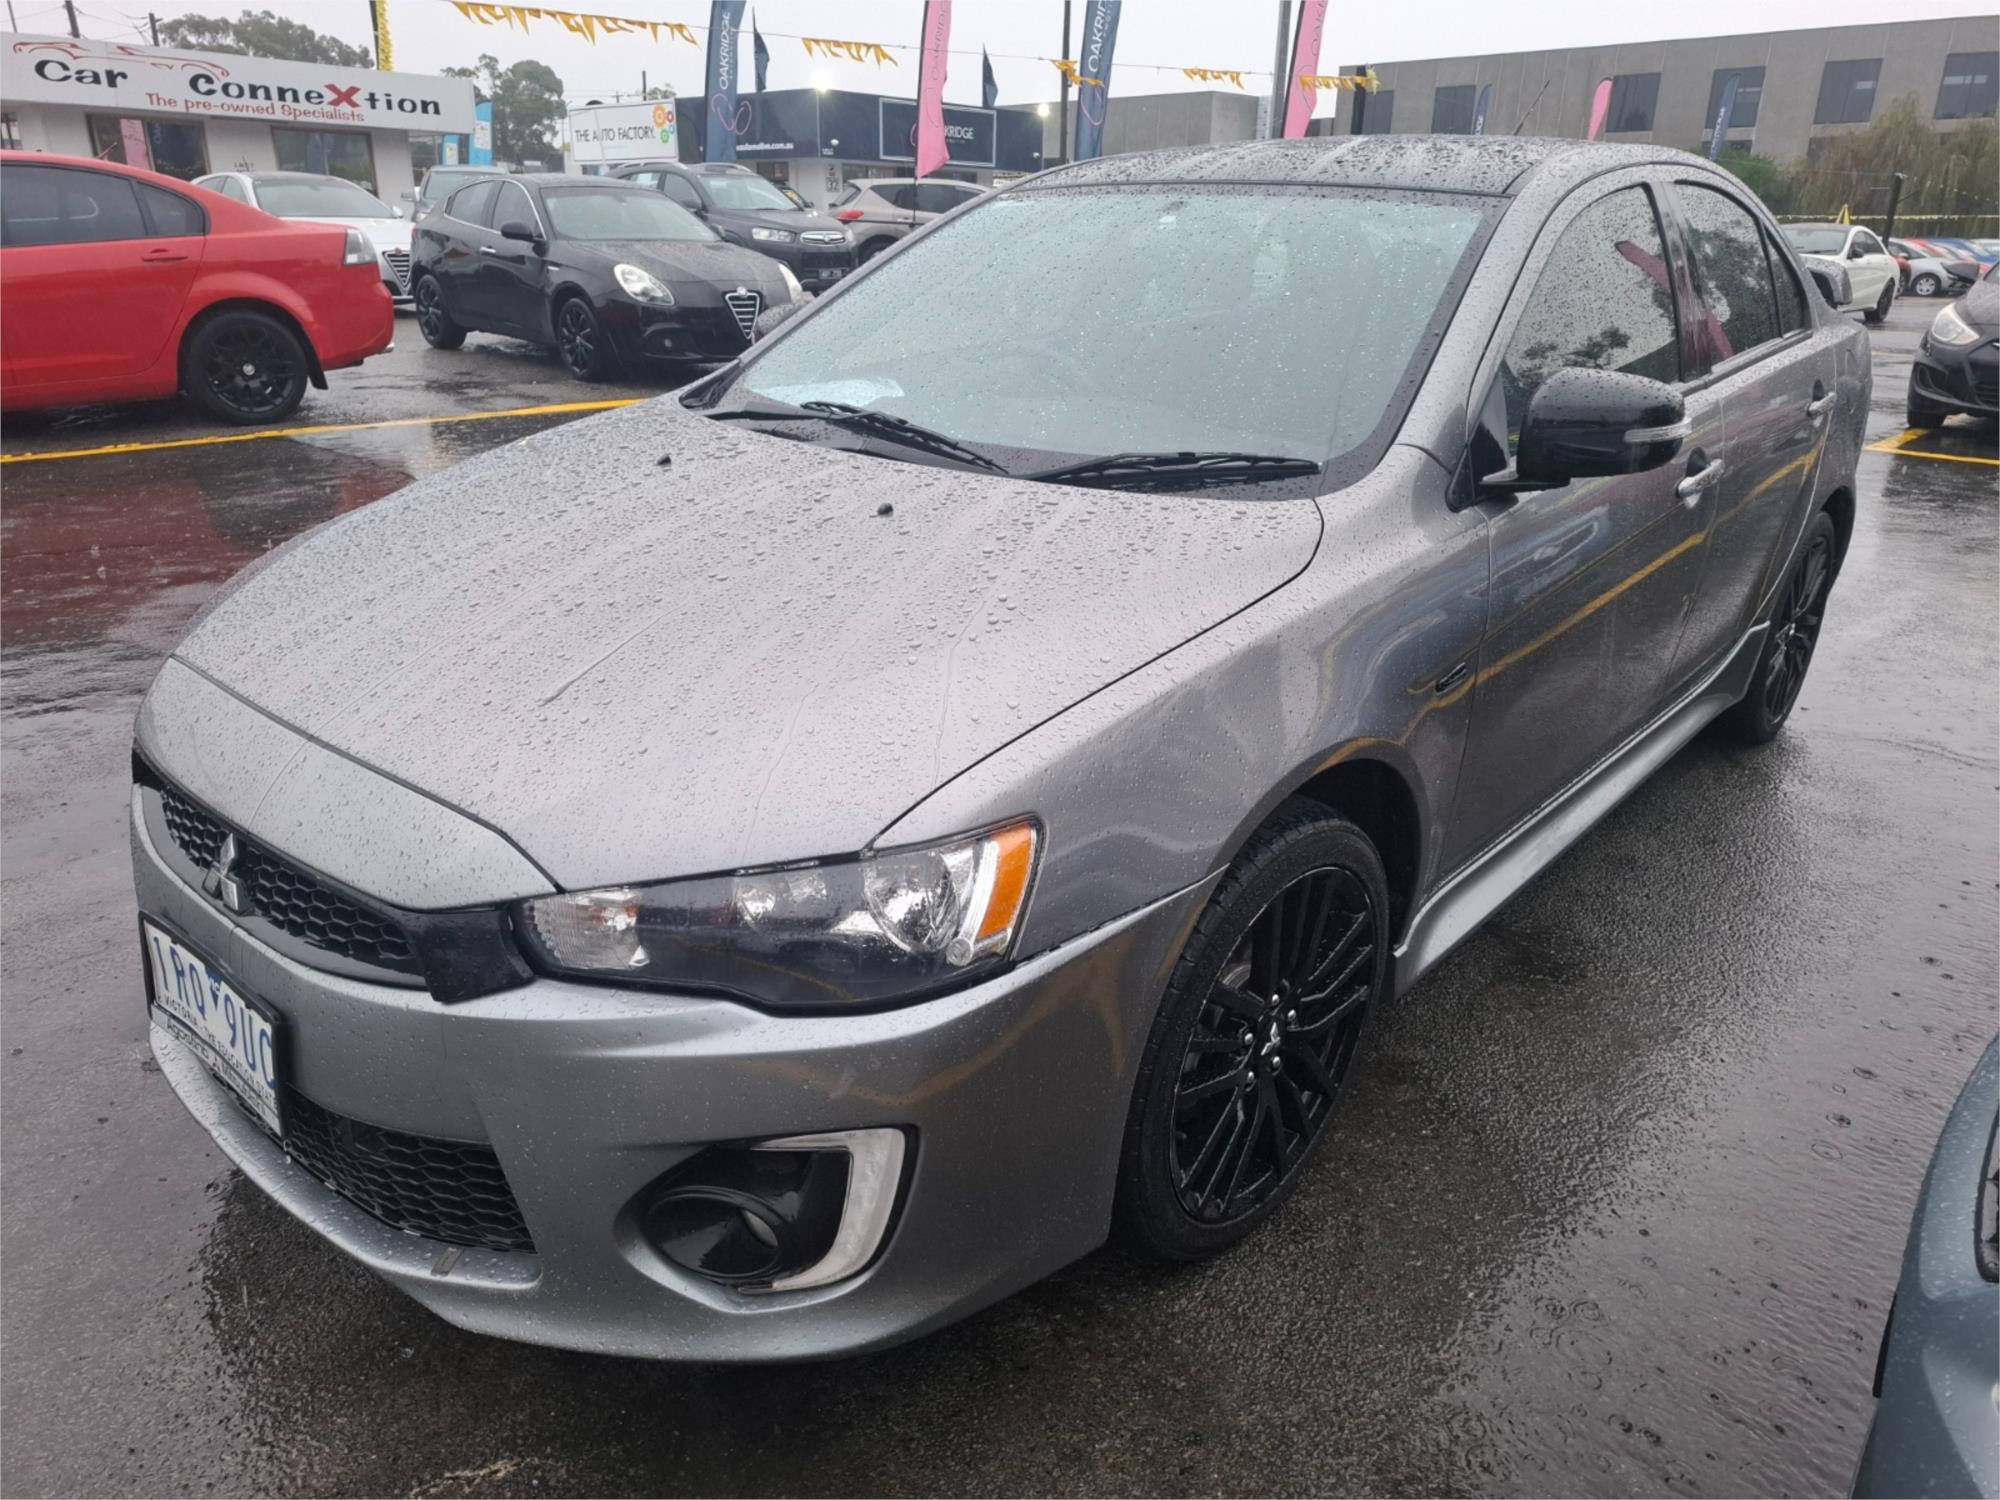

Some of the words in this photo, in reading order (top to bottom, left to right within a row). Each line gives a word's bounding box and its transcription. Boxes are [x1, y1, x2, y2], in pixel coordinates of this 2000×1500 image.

[720, 11, 730, 90] OAKRIDGE
[34, 59, 128, 88] Car
[189, 72, 441, 116] ConneXtion
[146, 93, 177, 107] The
[183, 98, 275, 115] pre-owned
[281, 104, 365, 121] Specialists
[575, 128, 590, 142] THE
[165, 995, 198, 1027] VICTORIA
